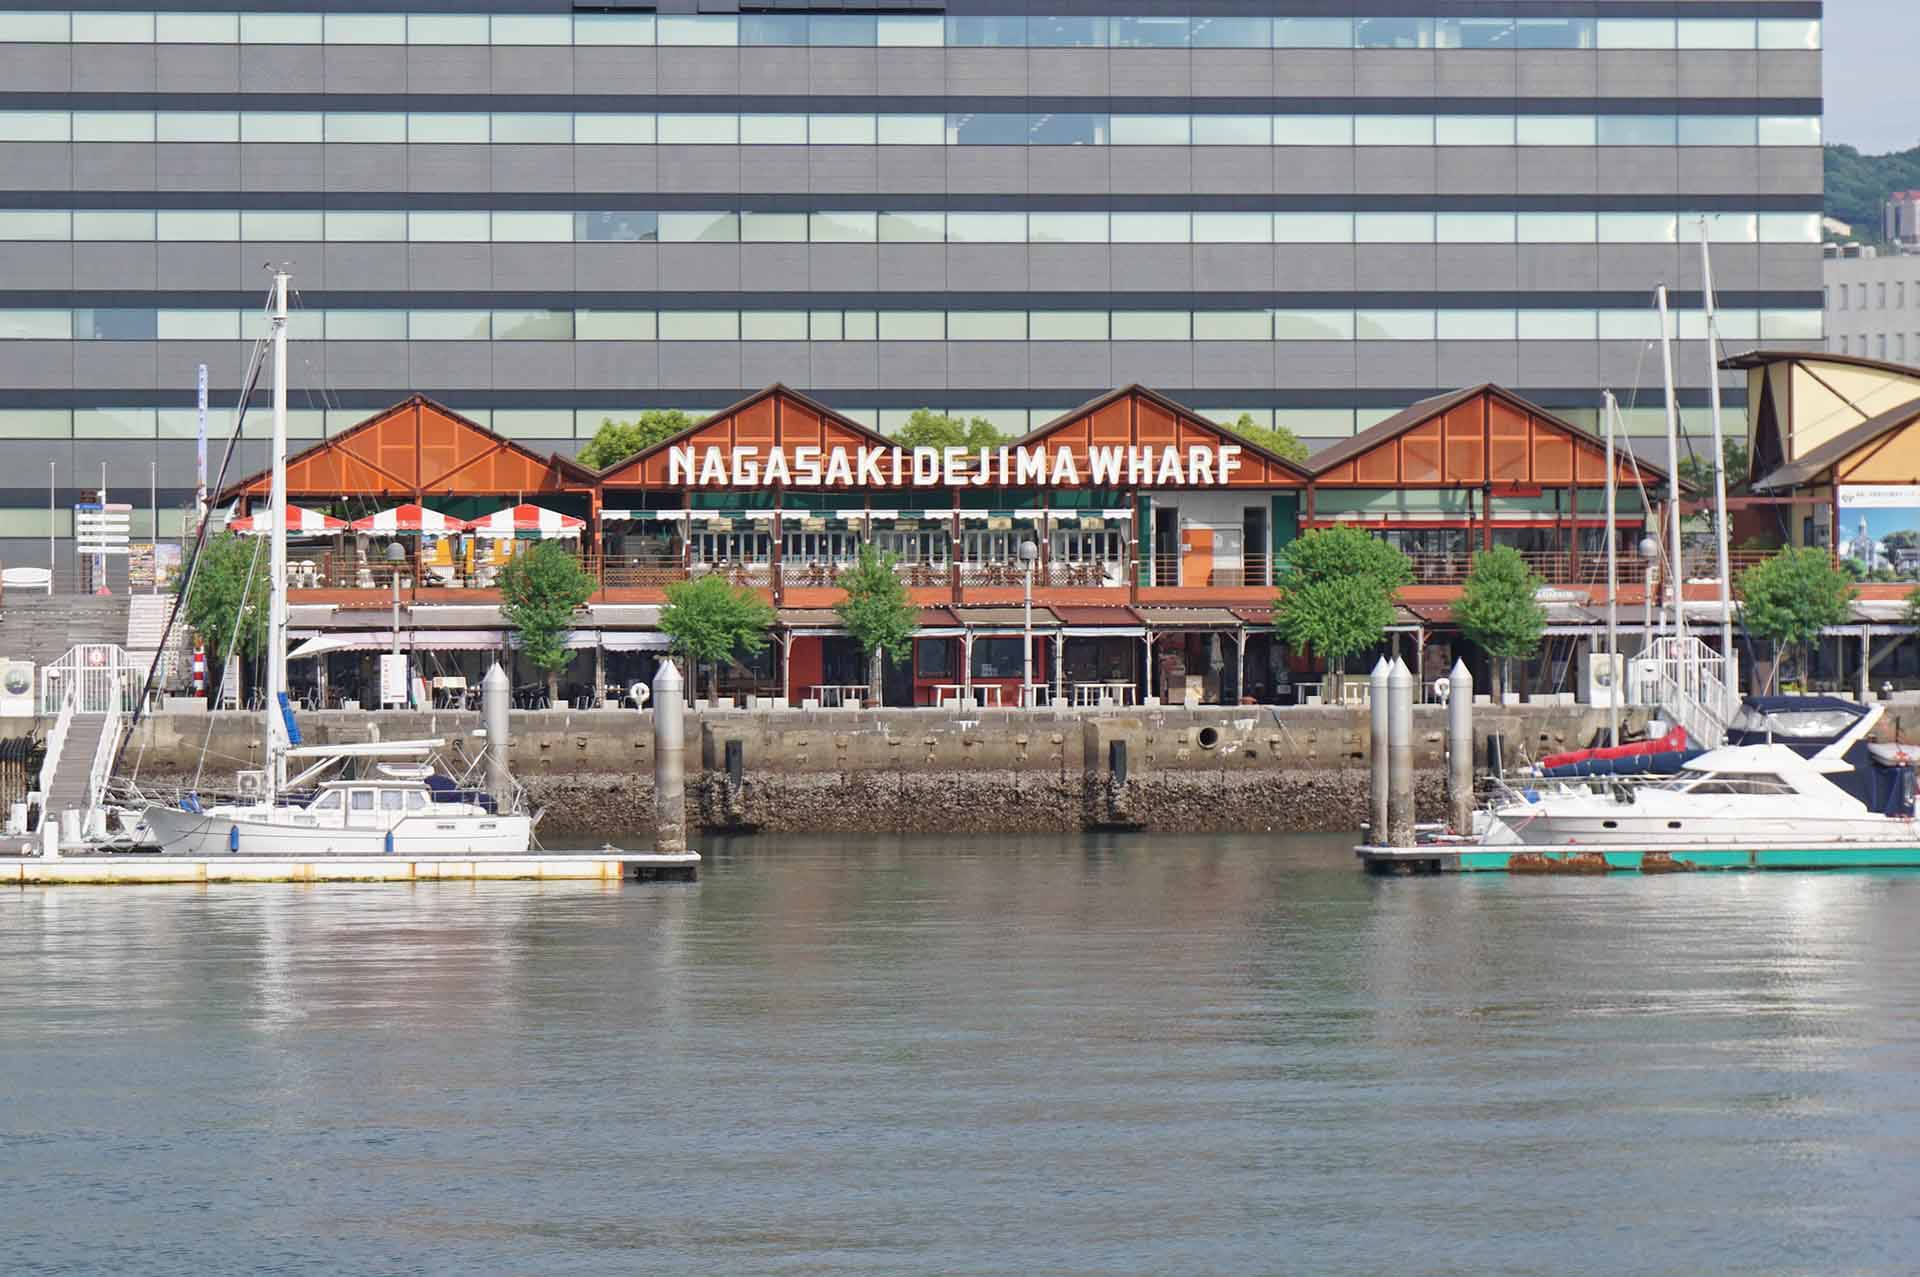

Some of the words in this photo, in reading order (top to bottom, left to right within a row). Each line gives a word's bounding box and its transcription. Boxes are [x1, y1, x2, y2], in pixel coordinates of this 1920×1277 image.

[668, 445, 903, 486] NAGASAKI
[912, 445, 1080, 486] DEJIMA
[1088, 445, 1242, 485] WHARF
